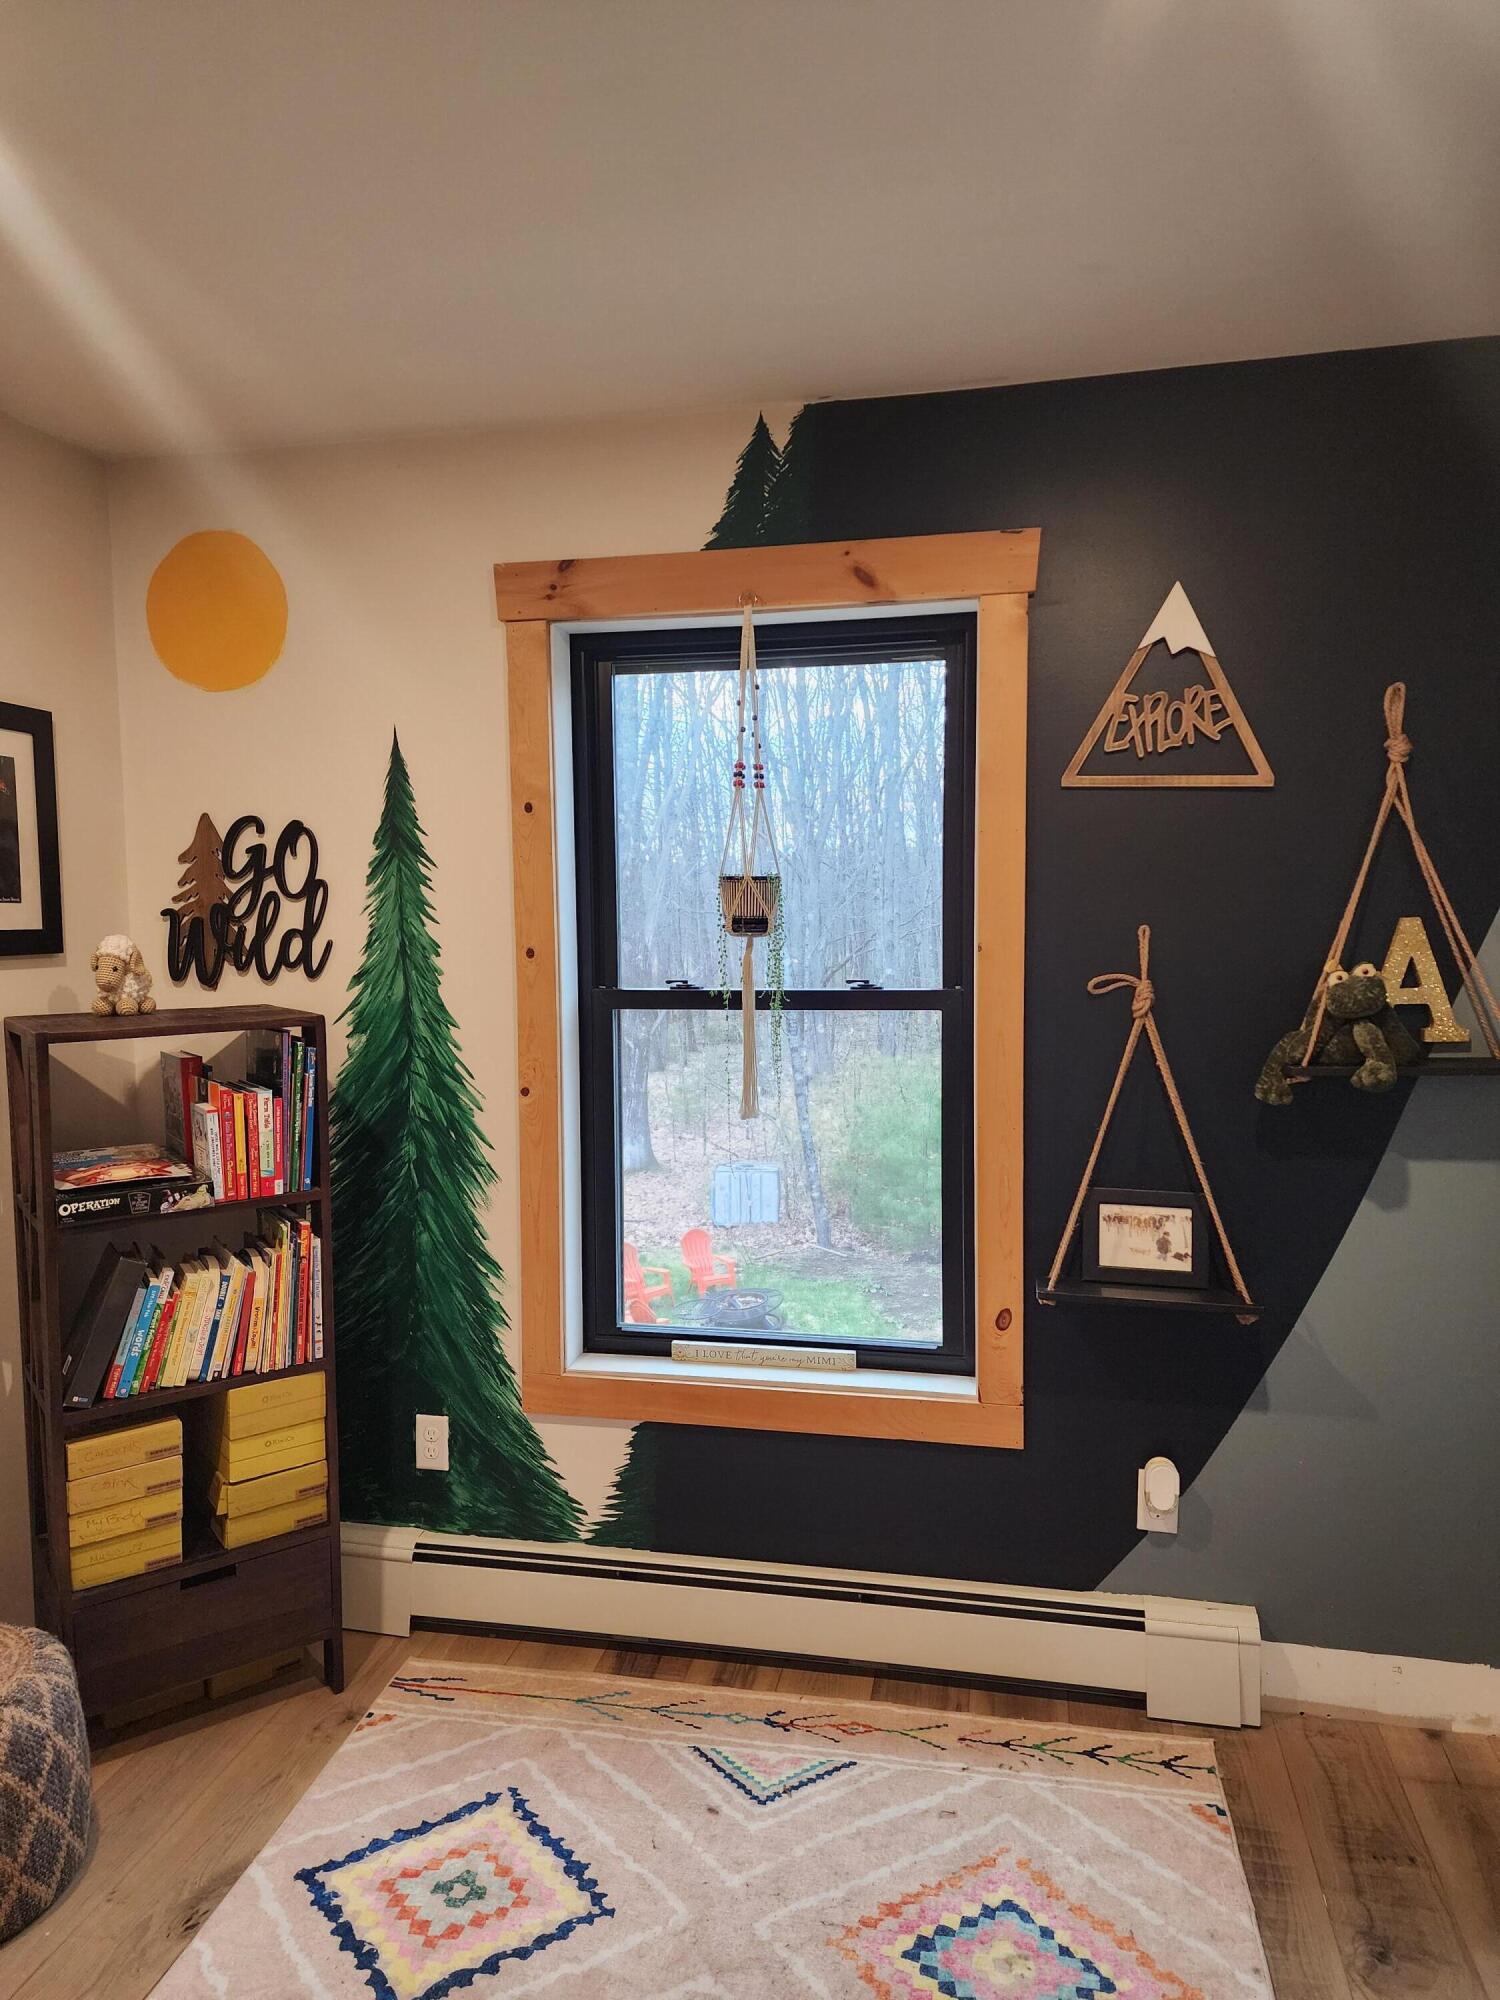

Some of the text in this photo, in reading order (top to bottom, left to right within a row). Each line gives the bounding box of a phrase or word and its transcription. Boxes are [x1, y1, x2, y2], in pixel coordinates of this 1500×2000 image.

[1104, 685, 1234, 758] EXPLORE
[1383, 916, 1472, 1043] A
[58, 1198, 121, 1217] OPERATION
[252, 1306, 260, 1326] Vroom
[130, 1328, 146, 1358] words
[701, 1349, 732, 1360] LOVE
[734, 1347, 759, 1361] that
[806, 1356, 837, 1366] MIMI
